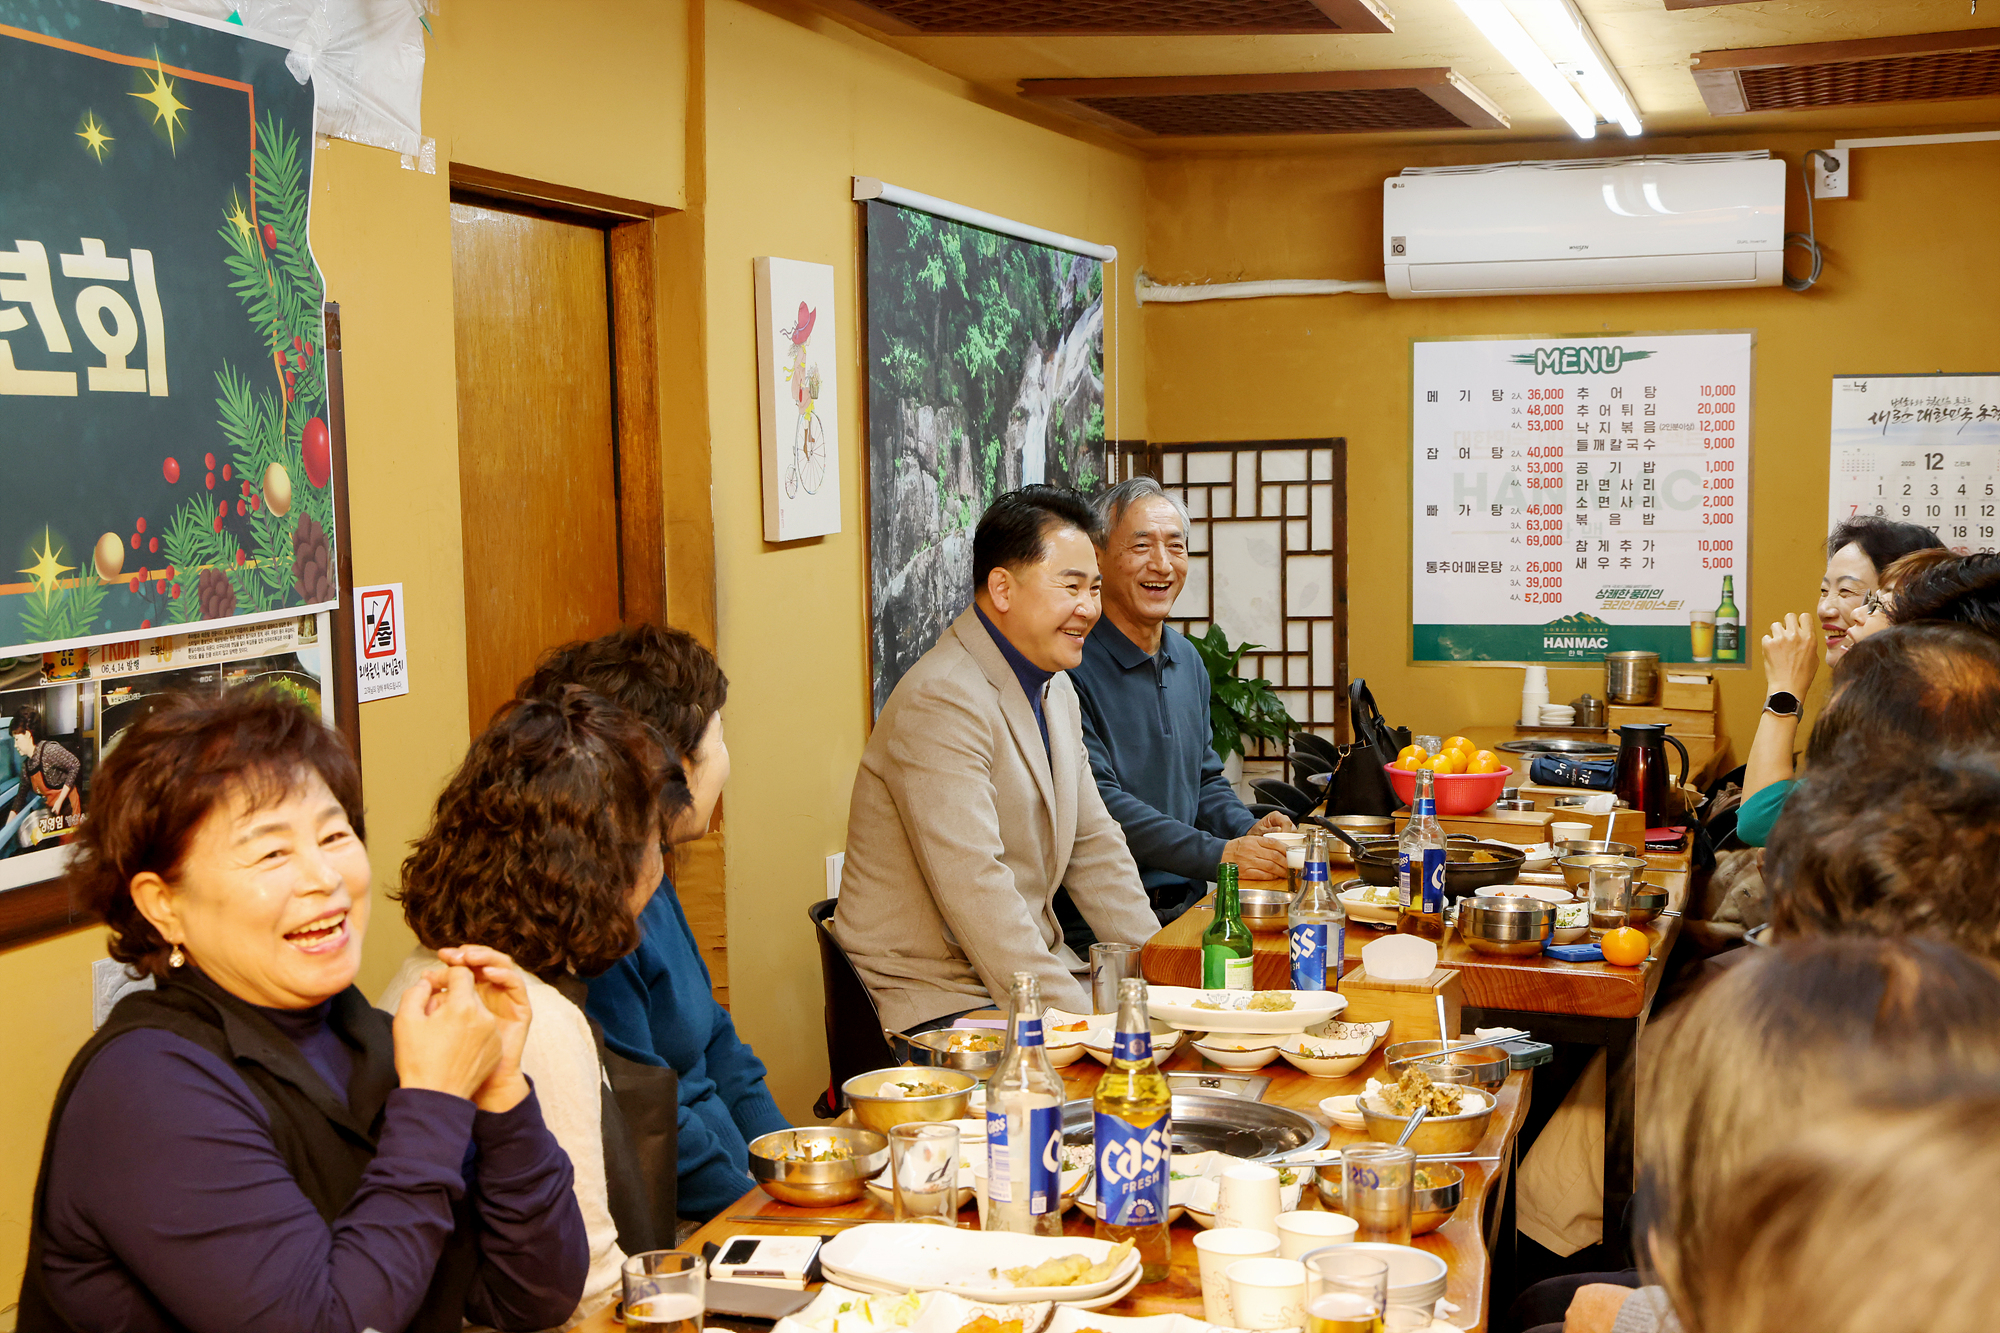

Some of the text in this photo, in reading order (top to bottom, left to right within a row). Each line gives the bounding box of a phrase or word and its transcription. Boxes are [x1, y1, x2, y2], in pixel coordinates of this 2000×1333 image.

[1536, 346, 1623, 375] MENU
[1528, 389, 1563, 400] 36,000
[1701, 385, 1735, 397] 10,000
[1527, 404, 1563, 416] 48,000
[1698, 403, 1735, 415] 20,000
[1528, 420, 1563, 432] 53,000
[1700, 420, 1735, 432] 12,000
[1704, 438, 1734, 450] 9,000
[1527, 446, 1563, 458] 40,000
[1706, 461, 1734, 473] 1,000
[1925, 453, 1944, 470] 12
[1528, 462, 1563, 474] 53,000
[1527, 478, 1563, 489] 58,000
[1703, 478, 1734, 490] 2,000
[1878, 484, 1994, 496] 1 2 3 4 5
[1703, 496, 1733, 508] 2,000
[1527, 504, 1563, 516] 46,000
[1850, 505, 1858, 516] 7
[1902, 505, 1910, 517] 9
[1926, 505, 1941, 517] 10
[1955, 505, 1966, 517] 11
[1981, 505, 1995, 517] 12
[1703, 513, 1733, 525] 3,000
[1527, 520, 1562, 531] 63,000
[1953, 526, 1967, 538] 18
[1980, 526, 1994, 538] 19
[1527, 535, 1562, 547] 69,000
[1698, 540, 1733, 552] 10,000
[1527, 562, 1562, 573] 26,000
[1703, 558, 1733, 569] 5,000
[1526, 577, 1562, 589] 39,000
[1525, 592, 1562, 604] 52,000
[1595, 589, 1665, 600] 상쾌한 풍미의
[1600, 600, 1635, 611] 코리안
[1543, 637, 1609, 649] HANMAC
[101, 663, 124, 674] 06.4.14
[382, 658, 404, 676] 반입금지
[1122, 1171, 1160, 1195] FRESH
